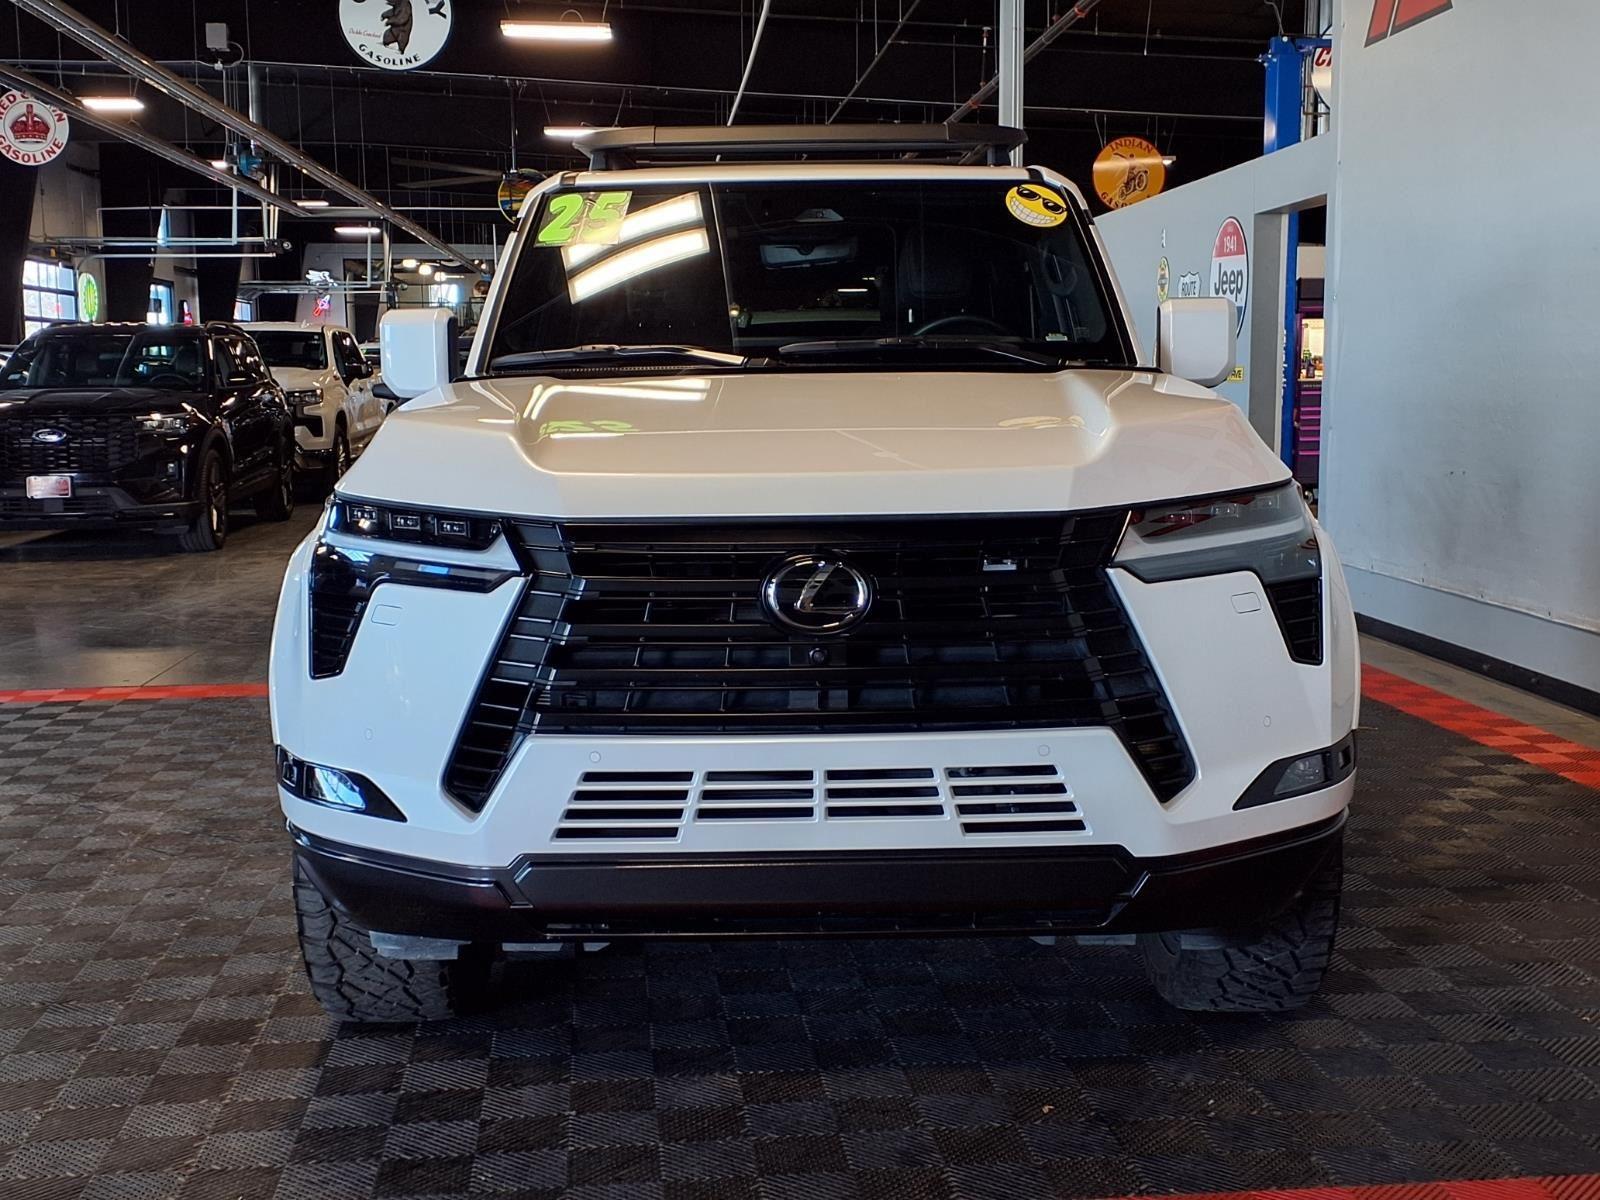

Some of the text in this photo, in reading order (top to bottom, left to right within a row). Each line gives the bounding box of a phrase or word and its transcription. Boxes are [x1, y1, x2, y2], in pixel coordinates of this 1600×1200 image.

[358, 44, 422, 66] GASOLINE
[1109, 138, 1153, 154] INDIAN
[538, 193, 628, 244] 25
[1223, 235, 1237, 253] 1941
[1181, 281, 1197, 296] ROUTE
[1214, 262, 1244, 302] Jeep
